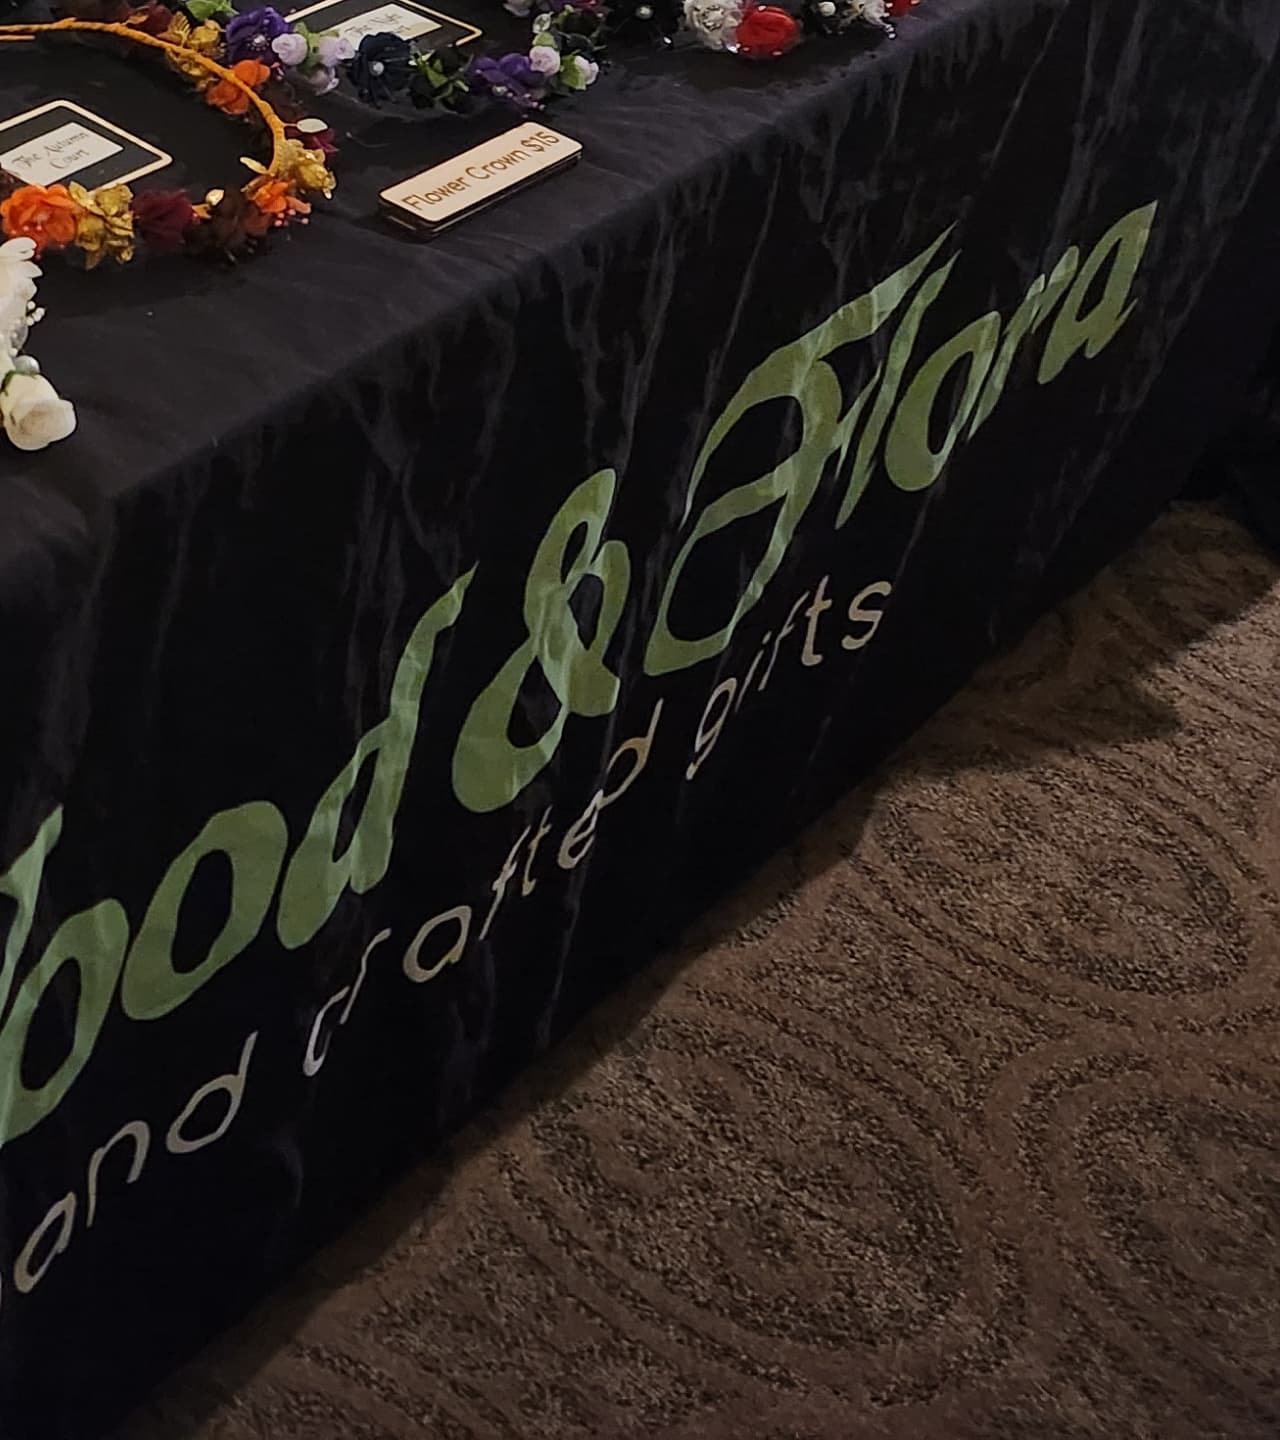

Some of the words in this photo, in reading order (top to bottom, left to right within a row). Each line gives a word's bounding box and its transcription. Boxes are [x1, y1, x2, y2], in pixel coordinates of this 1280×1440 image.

[9, 150, 45, 170] The
[44, 131, 91, 155] Autumn
[49, 146, 91, 170] Court
[400, 176, 472, 212] Flower
[465, 149, 531, 181] Crown
[519, 130, 561, 153] $15
[448, 466, 637, 816] &
[641, 197, 1160, 682] Flora
[298, 690, 676, 1082] crafted
[688, 570, 895, 784] gifts
